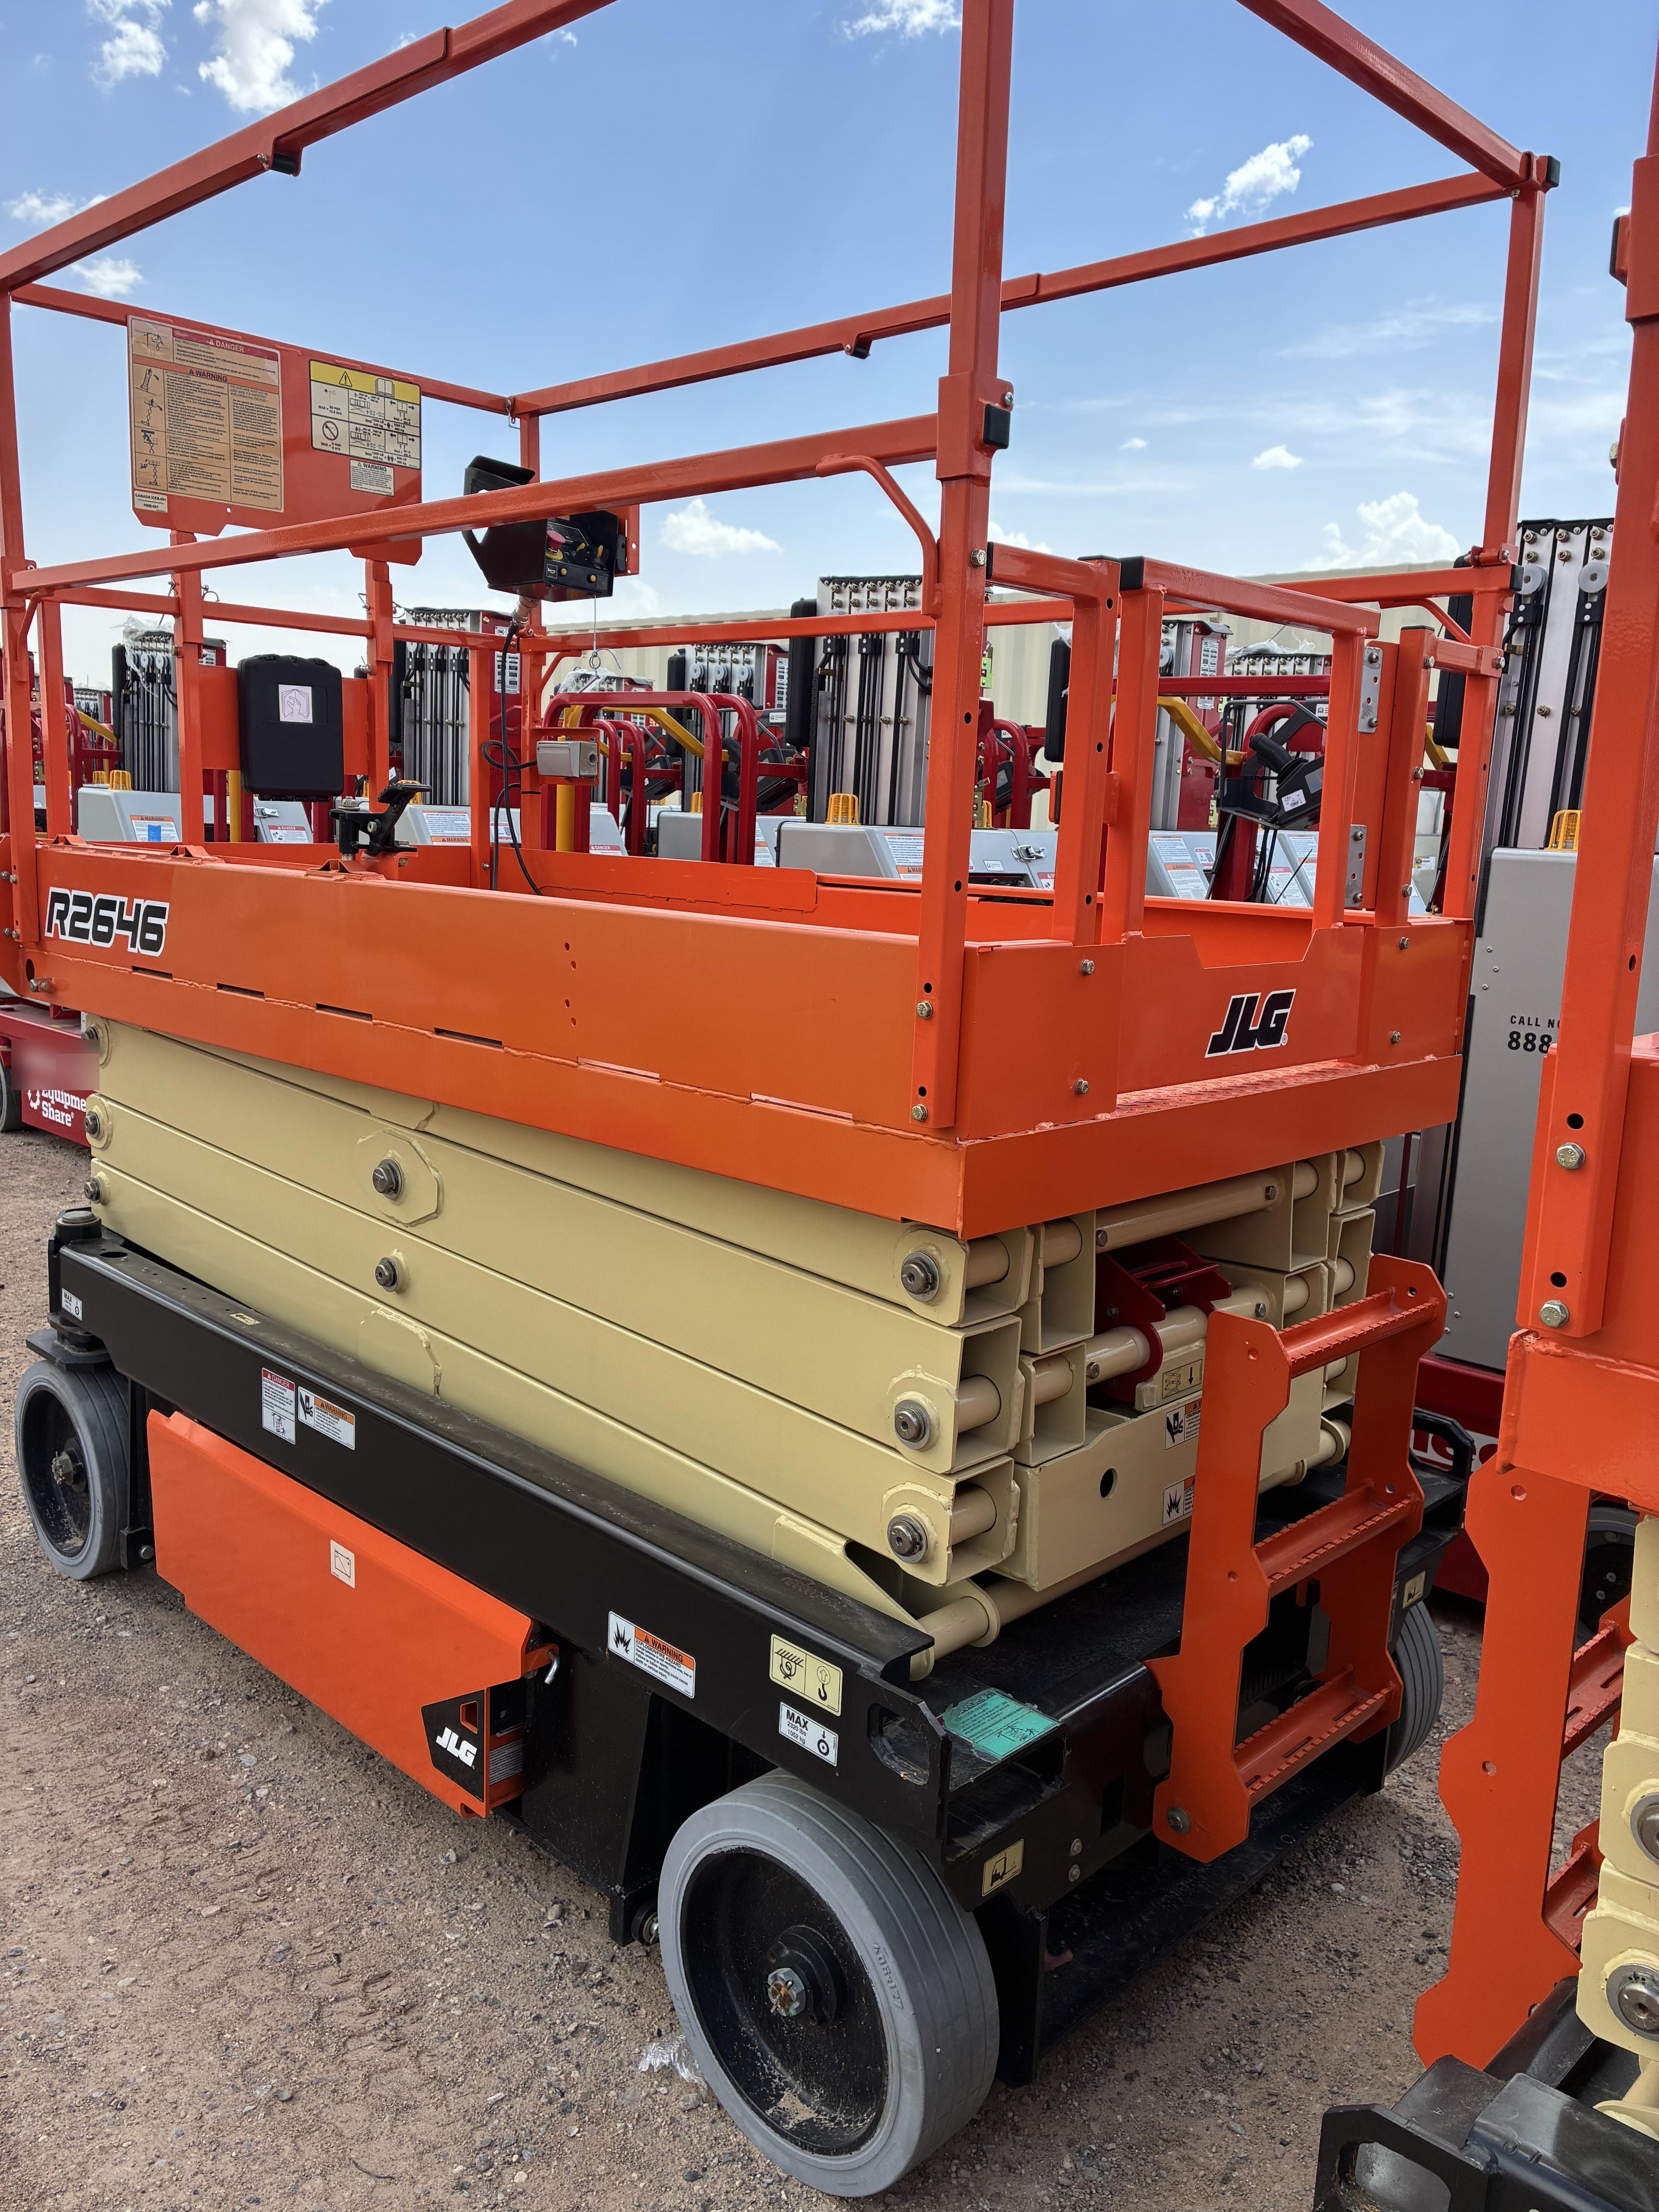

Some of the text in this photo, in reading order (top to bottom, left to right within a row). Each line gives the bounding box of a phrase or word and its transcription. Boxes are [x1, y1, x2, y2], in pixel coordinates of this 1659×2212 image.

[215, 340, 244, 352] DANGER
[196, 370, 228, 382] WARNING
[363, 463, 387, 472] WARNING
[45, 889, 168, 955] R2646
[1206, 989, 1295, 1056] JLG
[1510, 1015, 1540, 1026] CALL
[1508, 1031, 1552, 1054] 888
[41, 1090, 87, 1112] Equipme
[41, 1100, 72, 1127] Share
[64, 1292, 72, 1302] MAX
[272, 1374, 290, 1388] DANGER
[325, 1401, 347, 1420] WARNING
[635, 1652, 646, 1661] Failure
[651, 1638, 683, 1663] WARNING
[665, 1656, 681, 1668] HAZARD
[786, 1709, 808, 1731] MAX
[787, 1721, 799, 1731] 2320
[787, 1729, 806, 1745] 1052 kg
[436, 1727, 477, 1767] JLG
